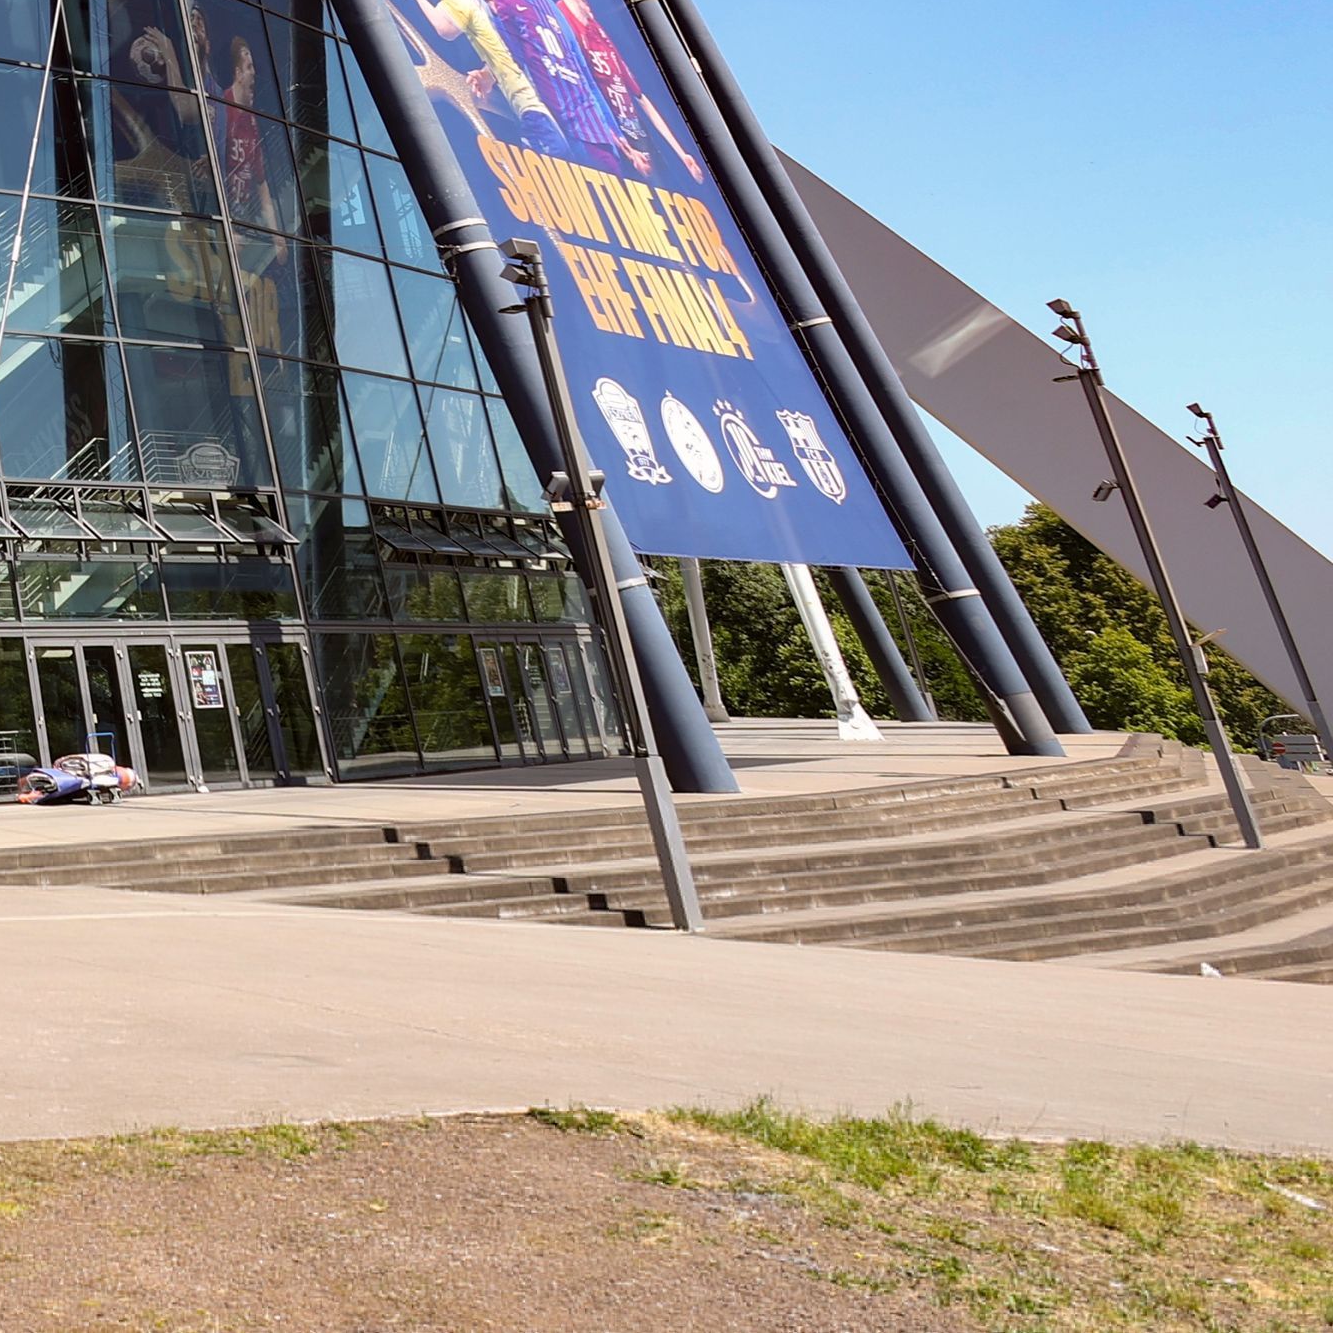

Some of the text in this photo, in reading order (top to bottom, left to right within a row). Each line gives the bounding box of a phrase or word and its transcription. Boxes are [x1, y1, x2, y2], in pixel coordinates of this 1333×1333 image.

[476, 133, 739, 277] SHOWTIME FOR
[558, 242, 754, 361] EHF FINAL4
